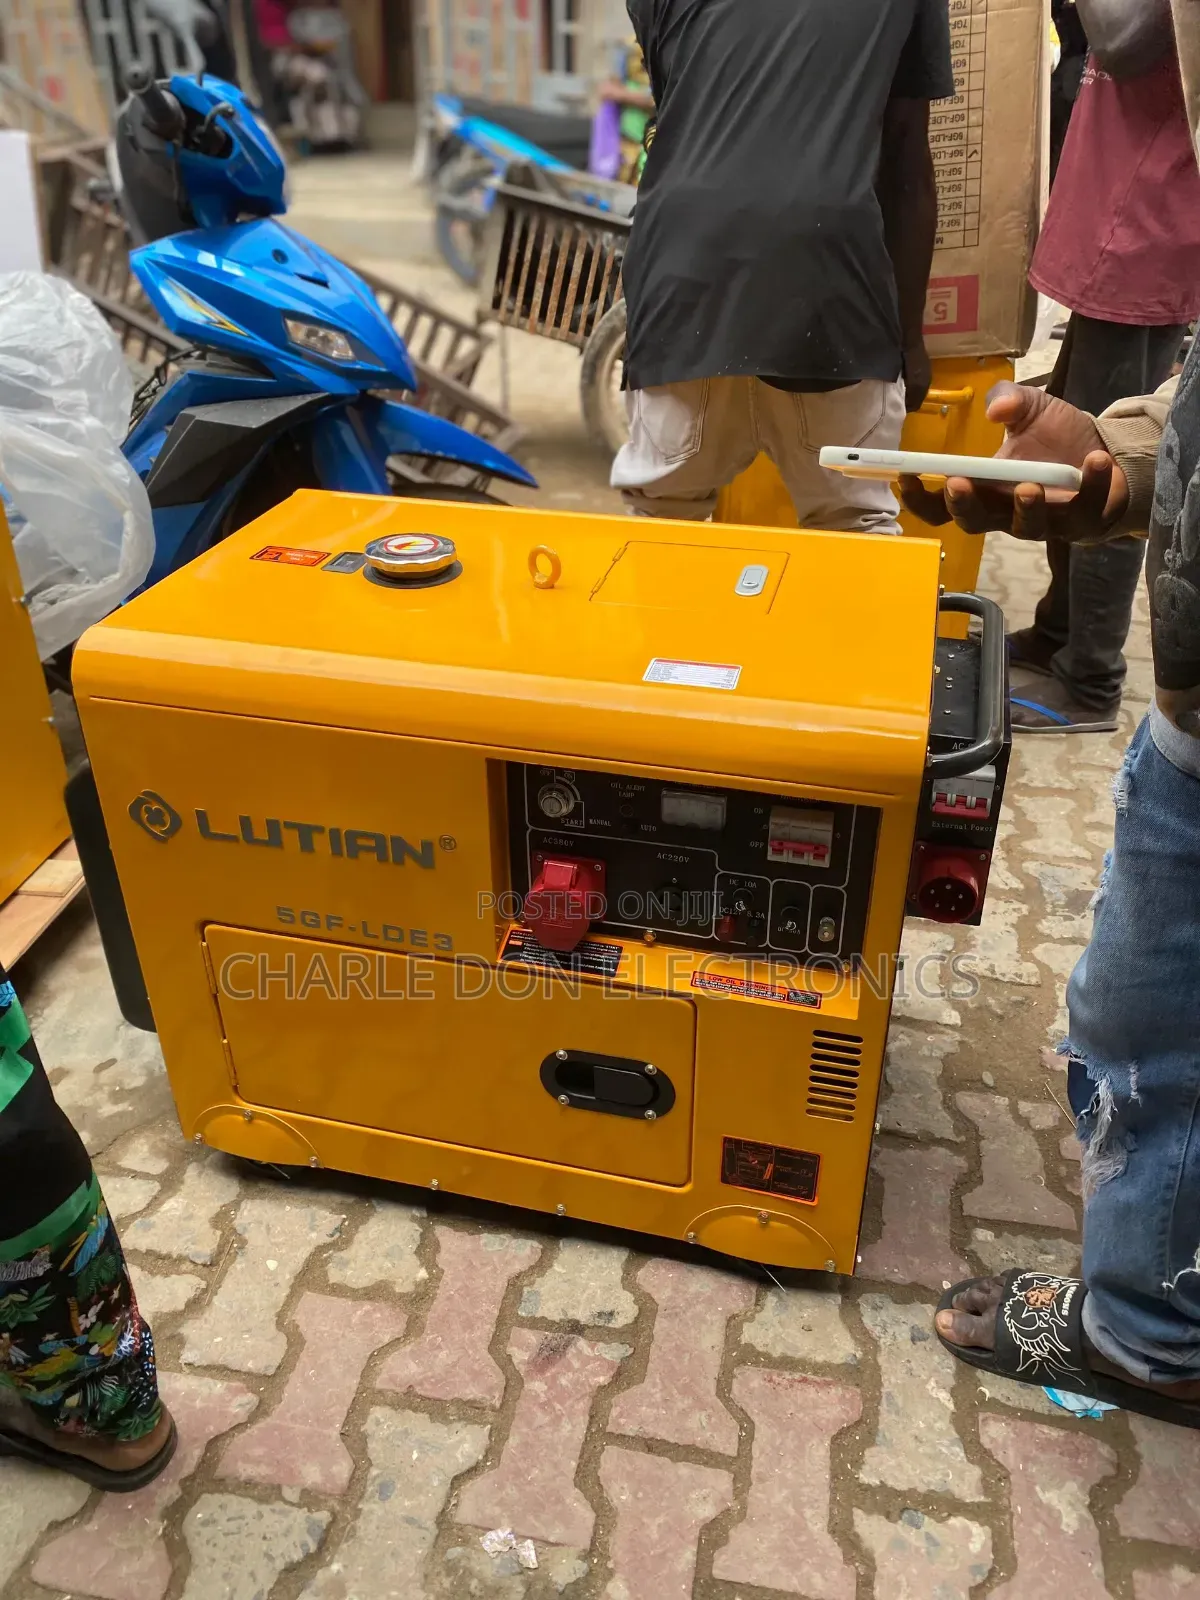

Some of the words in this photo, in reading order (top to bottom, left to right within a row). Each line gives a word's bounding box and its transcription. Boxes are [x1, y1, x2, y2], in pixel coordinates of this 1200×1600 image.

[933, 302, 948, 322] 5
[753, 807, 764, 815] ON
[560, 818, 583, 826] START
[931, 821, 967, 830] External
[970, 824, 993, 832] Power
[542, 836, 575, 847] AC380V
[749, 841, 765, 849] OFF
[656, 853, 690, 865] AC220V
[744, 880, 757, 889] 10A
[276, 904, 454, 951] 5GF-LDE3
